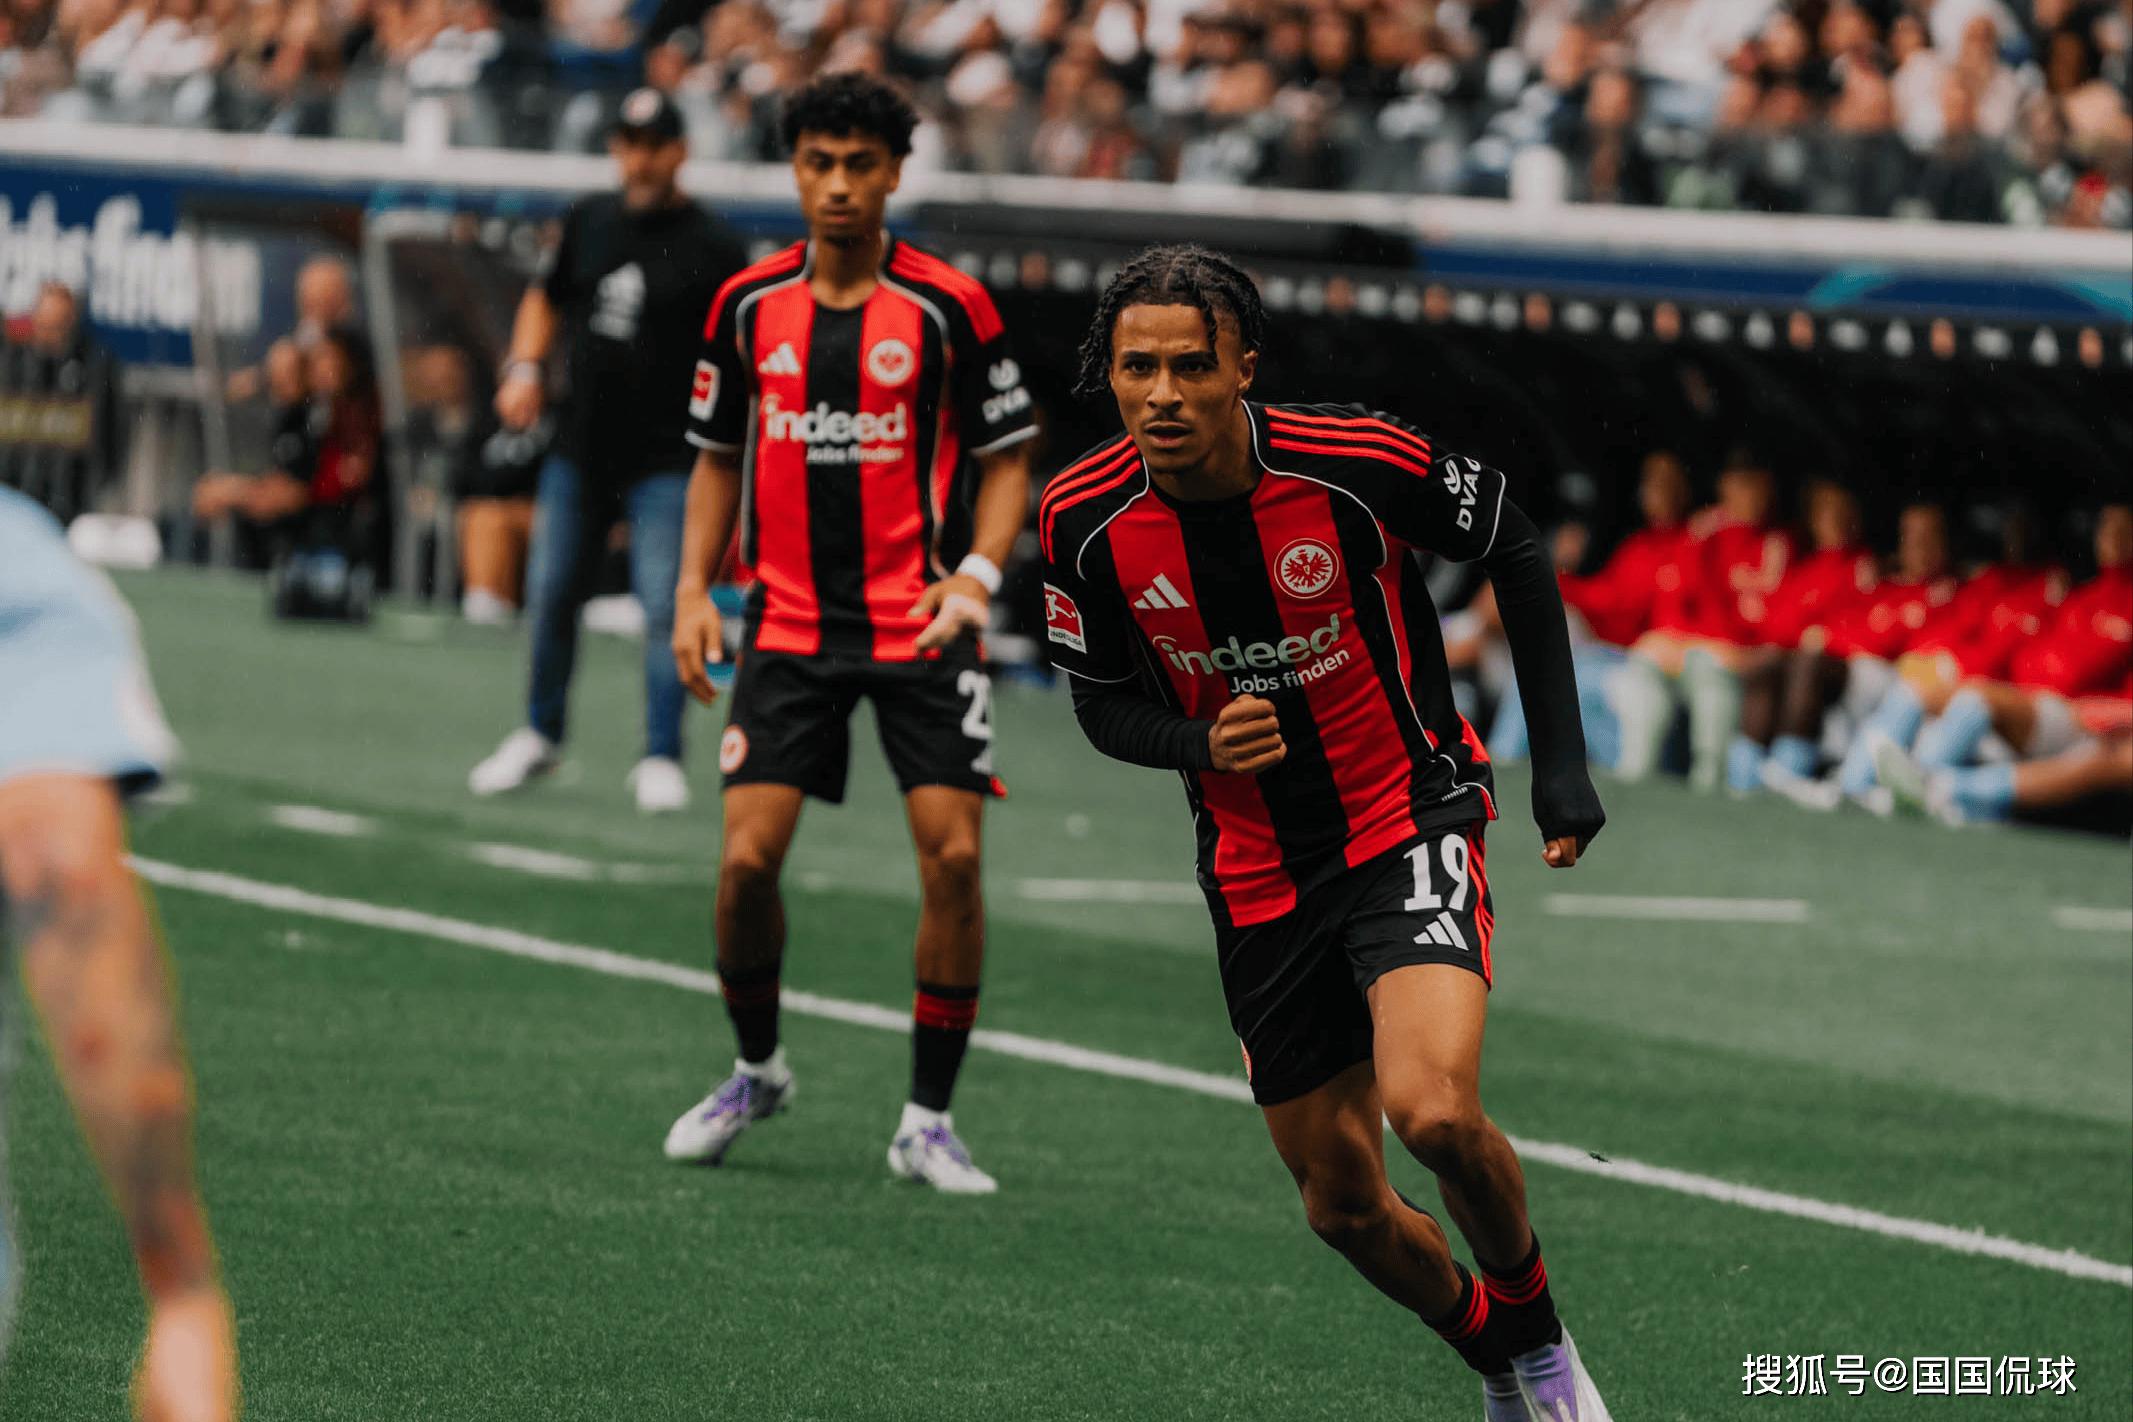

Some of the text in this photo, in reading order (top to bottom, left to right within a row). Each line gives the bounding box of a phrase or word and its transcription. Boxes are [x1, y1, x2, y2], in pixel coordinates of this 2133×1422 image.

[762, 394, 908, 443] indeed
[1153, 613, 1341, 675] indeed
[1231, 649, 1351, 694] Jobs finden
[1403, 834, 1470, 912] 19
